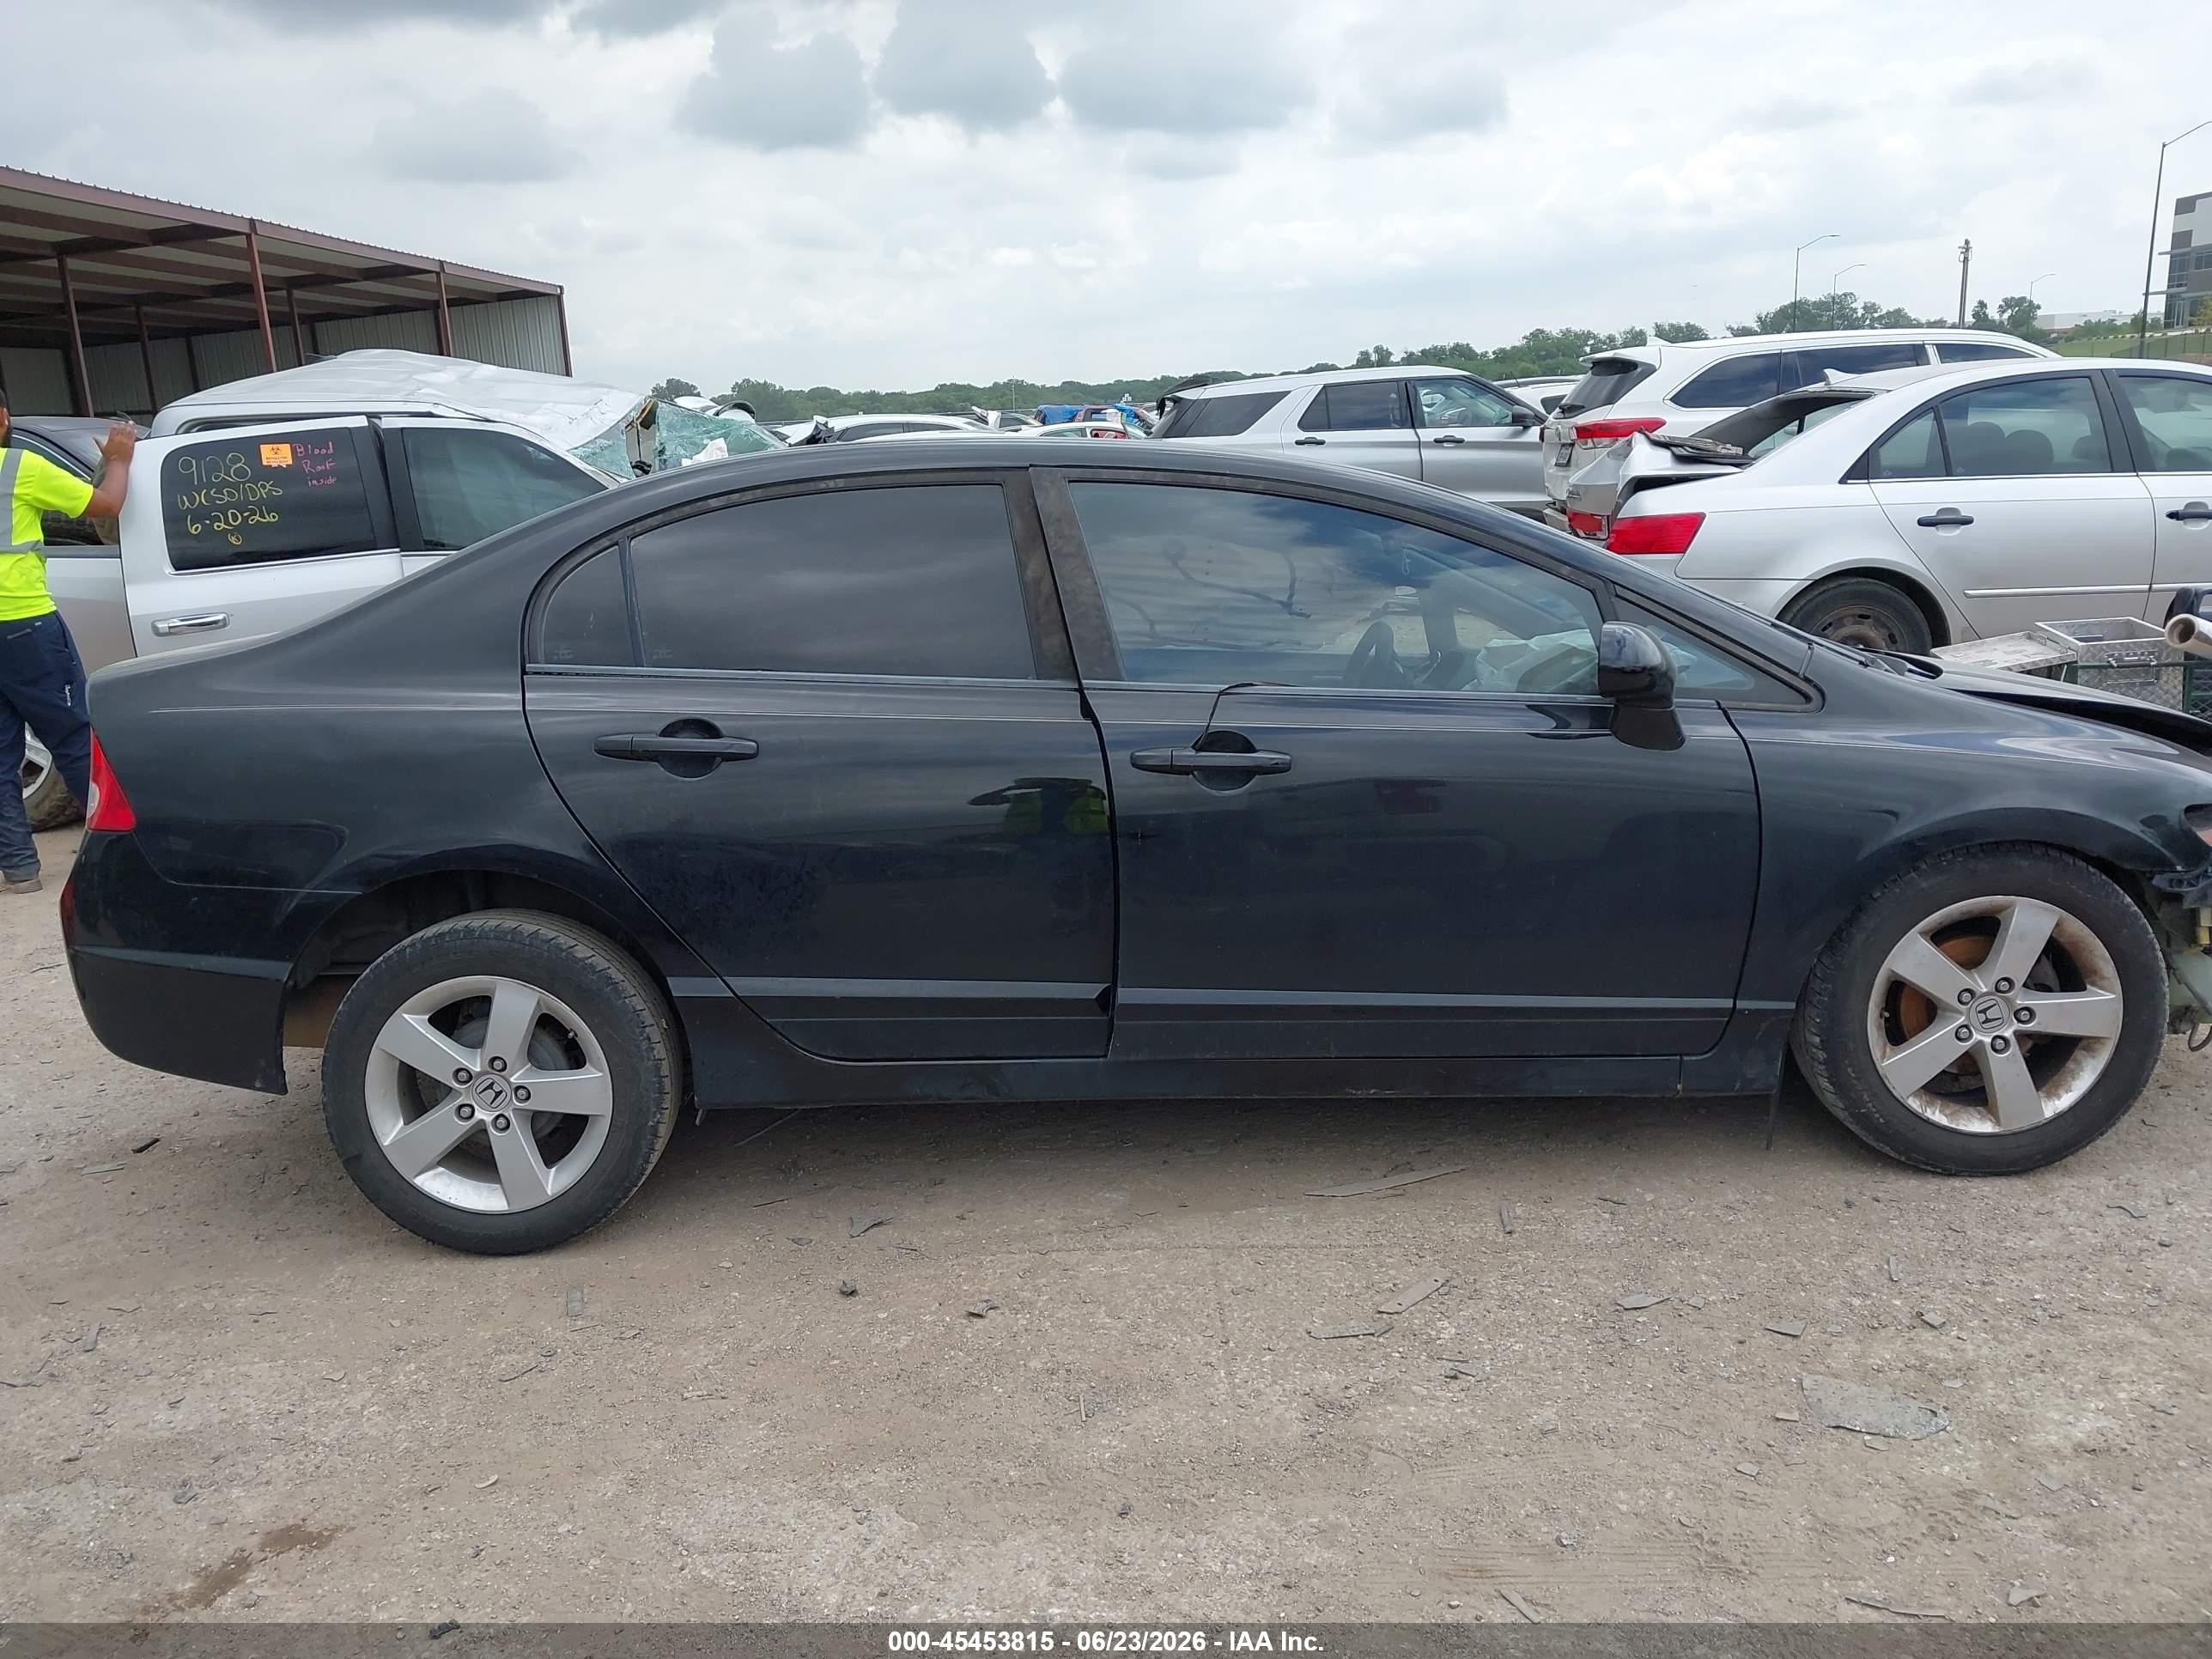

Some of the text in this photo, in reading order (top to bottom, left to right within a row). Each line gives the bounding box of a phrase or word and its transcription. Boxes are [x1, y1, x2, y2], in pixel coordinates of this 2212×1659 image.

[293, 441, 334, 457] Blood
[178, 453, 252, 486] 9128
[186, 505, 279, 534] 6-20-26
